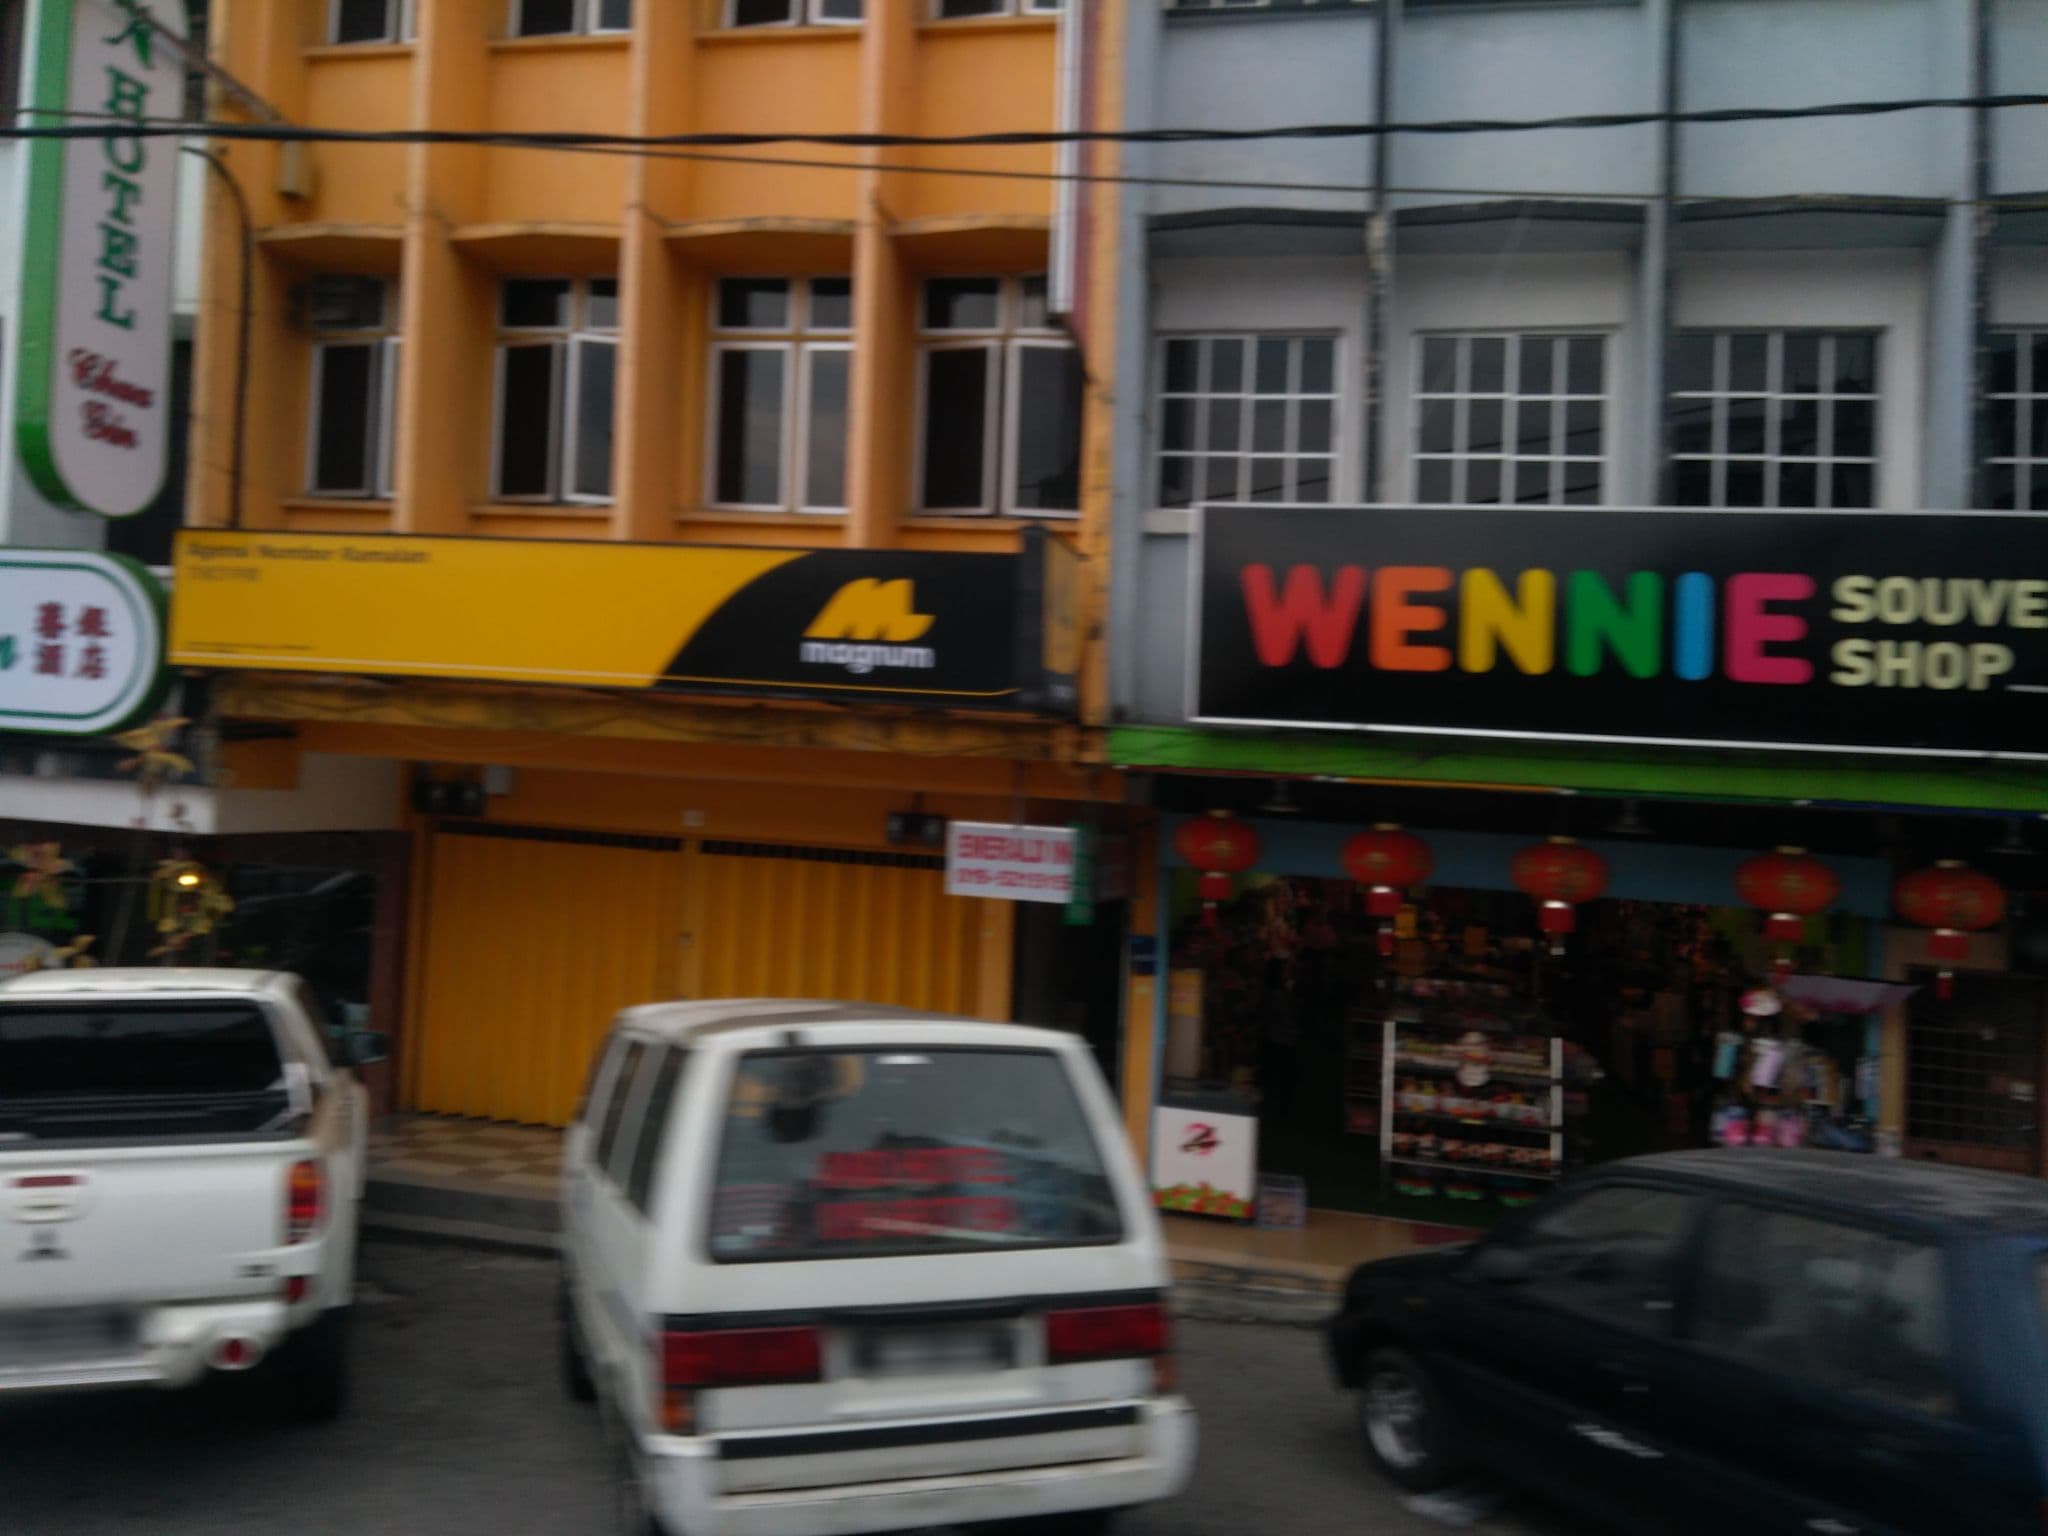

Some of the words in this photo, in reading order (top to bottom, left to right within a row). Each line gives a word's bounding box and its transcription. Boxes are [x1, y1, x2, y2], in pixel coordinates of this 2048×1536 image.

[1241, 563, 1816, 684] WENNIE
[1829, 574, 2048, 628] SOUVE
[800, 641, 936, 674] magnum
[1829, 638, 2015, 690] SHOP
